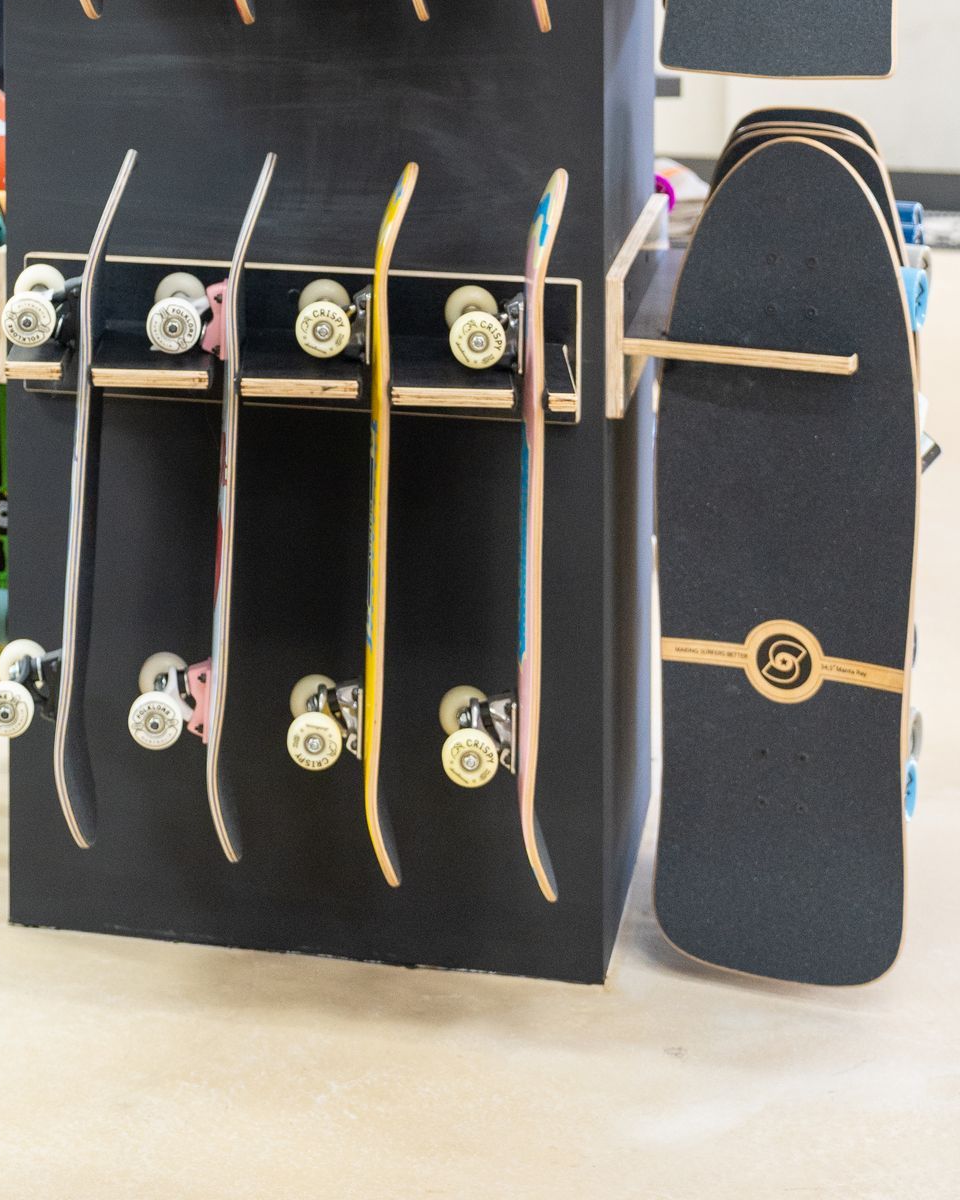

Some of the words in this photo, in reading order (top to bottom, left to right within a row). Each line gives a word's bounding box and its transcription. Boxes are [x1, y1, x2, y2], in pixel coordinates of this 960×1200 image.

[171, 308, 193, 338] FOLKLORE
[313, 308, 345, 328] CRISPY
[7, 323, 41, 342] FOLKLORE
[479, 320, 503, 351] CRISPY
[136, 705, 171, 719] FOLKLORE
[295, 752, 329, 768] CRISPY
[465, 739, 495, 764] CRISPY
